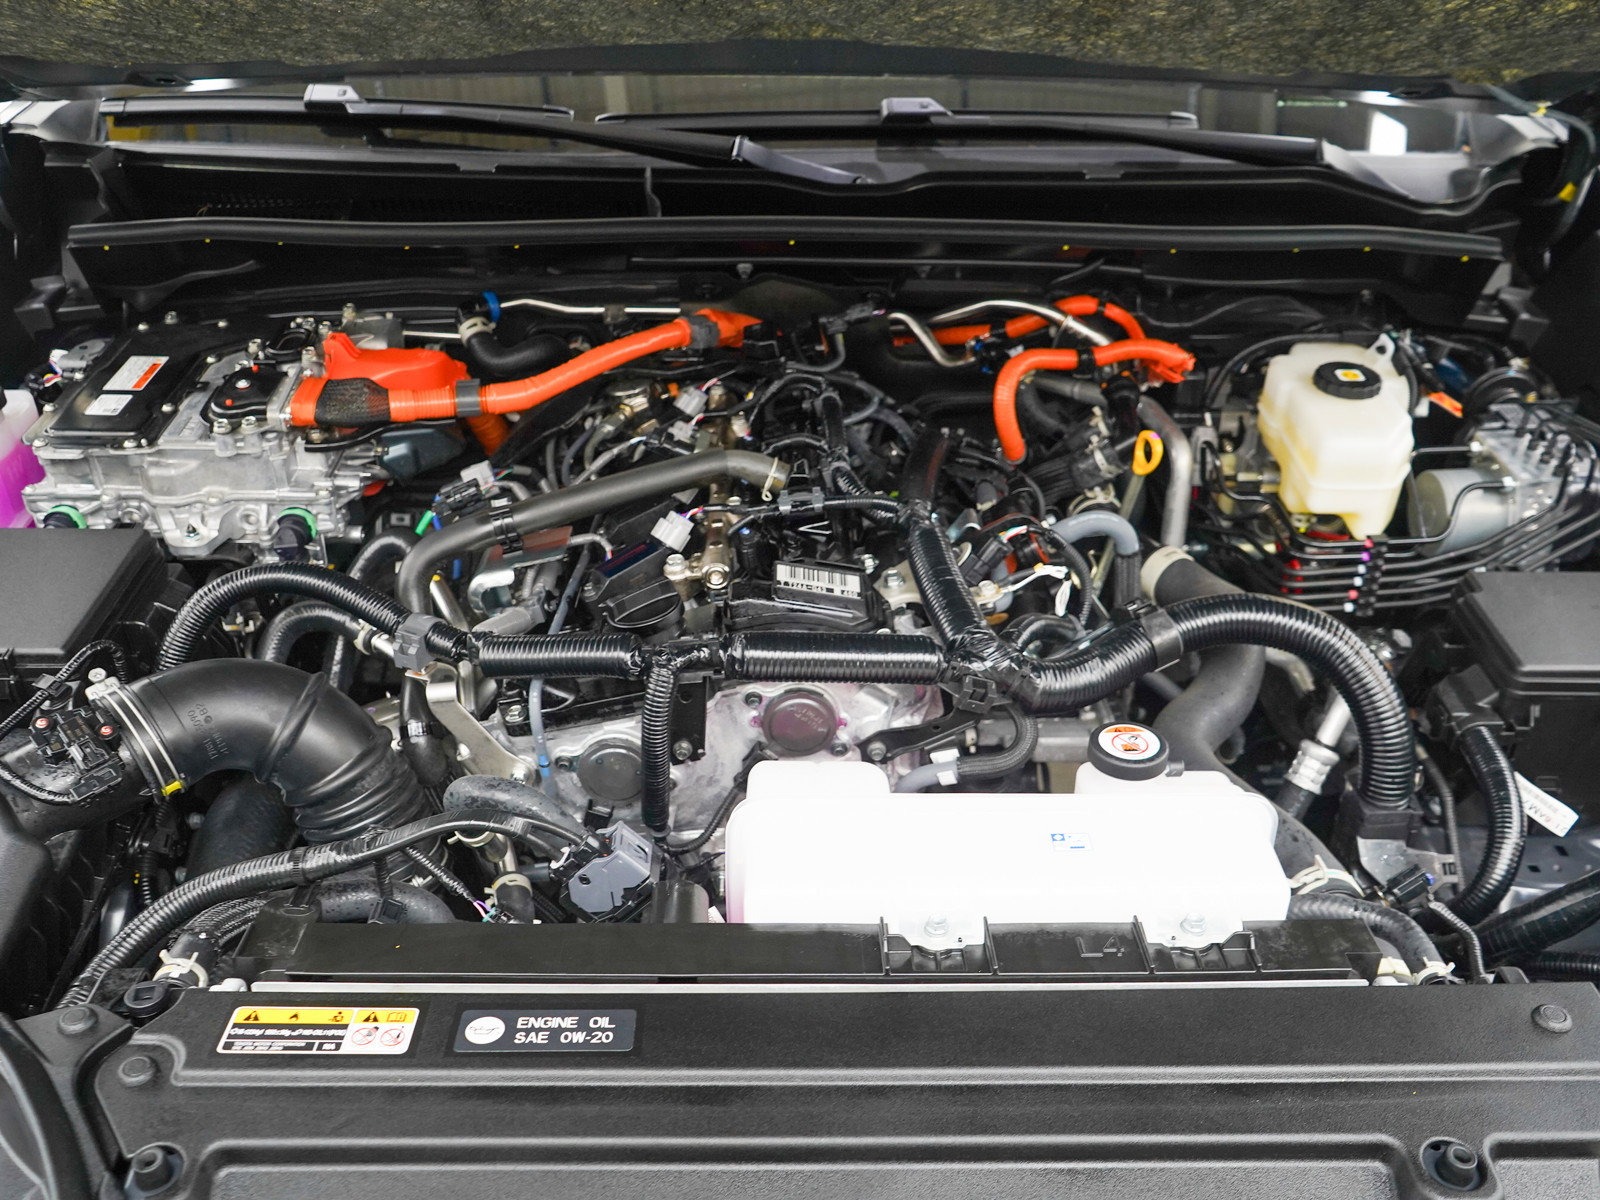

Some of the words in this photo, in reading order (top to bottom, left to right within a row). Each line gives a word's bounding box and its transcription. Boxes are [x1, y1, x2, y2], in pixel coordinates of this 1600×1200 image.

[516, 1016, 579, 1029] ENGINE
[589, 1016, 616, 1028] OIL
[514, 1031, 550, 1044] SAE
[560, 1031, 614, 1044] 0W-20
